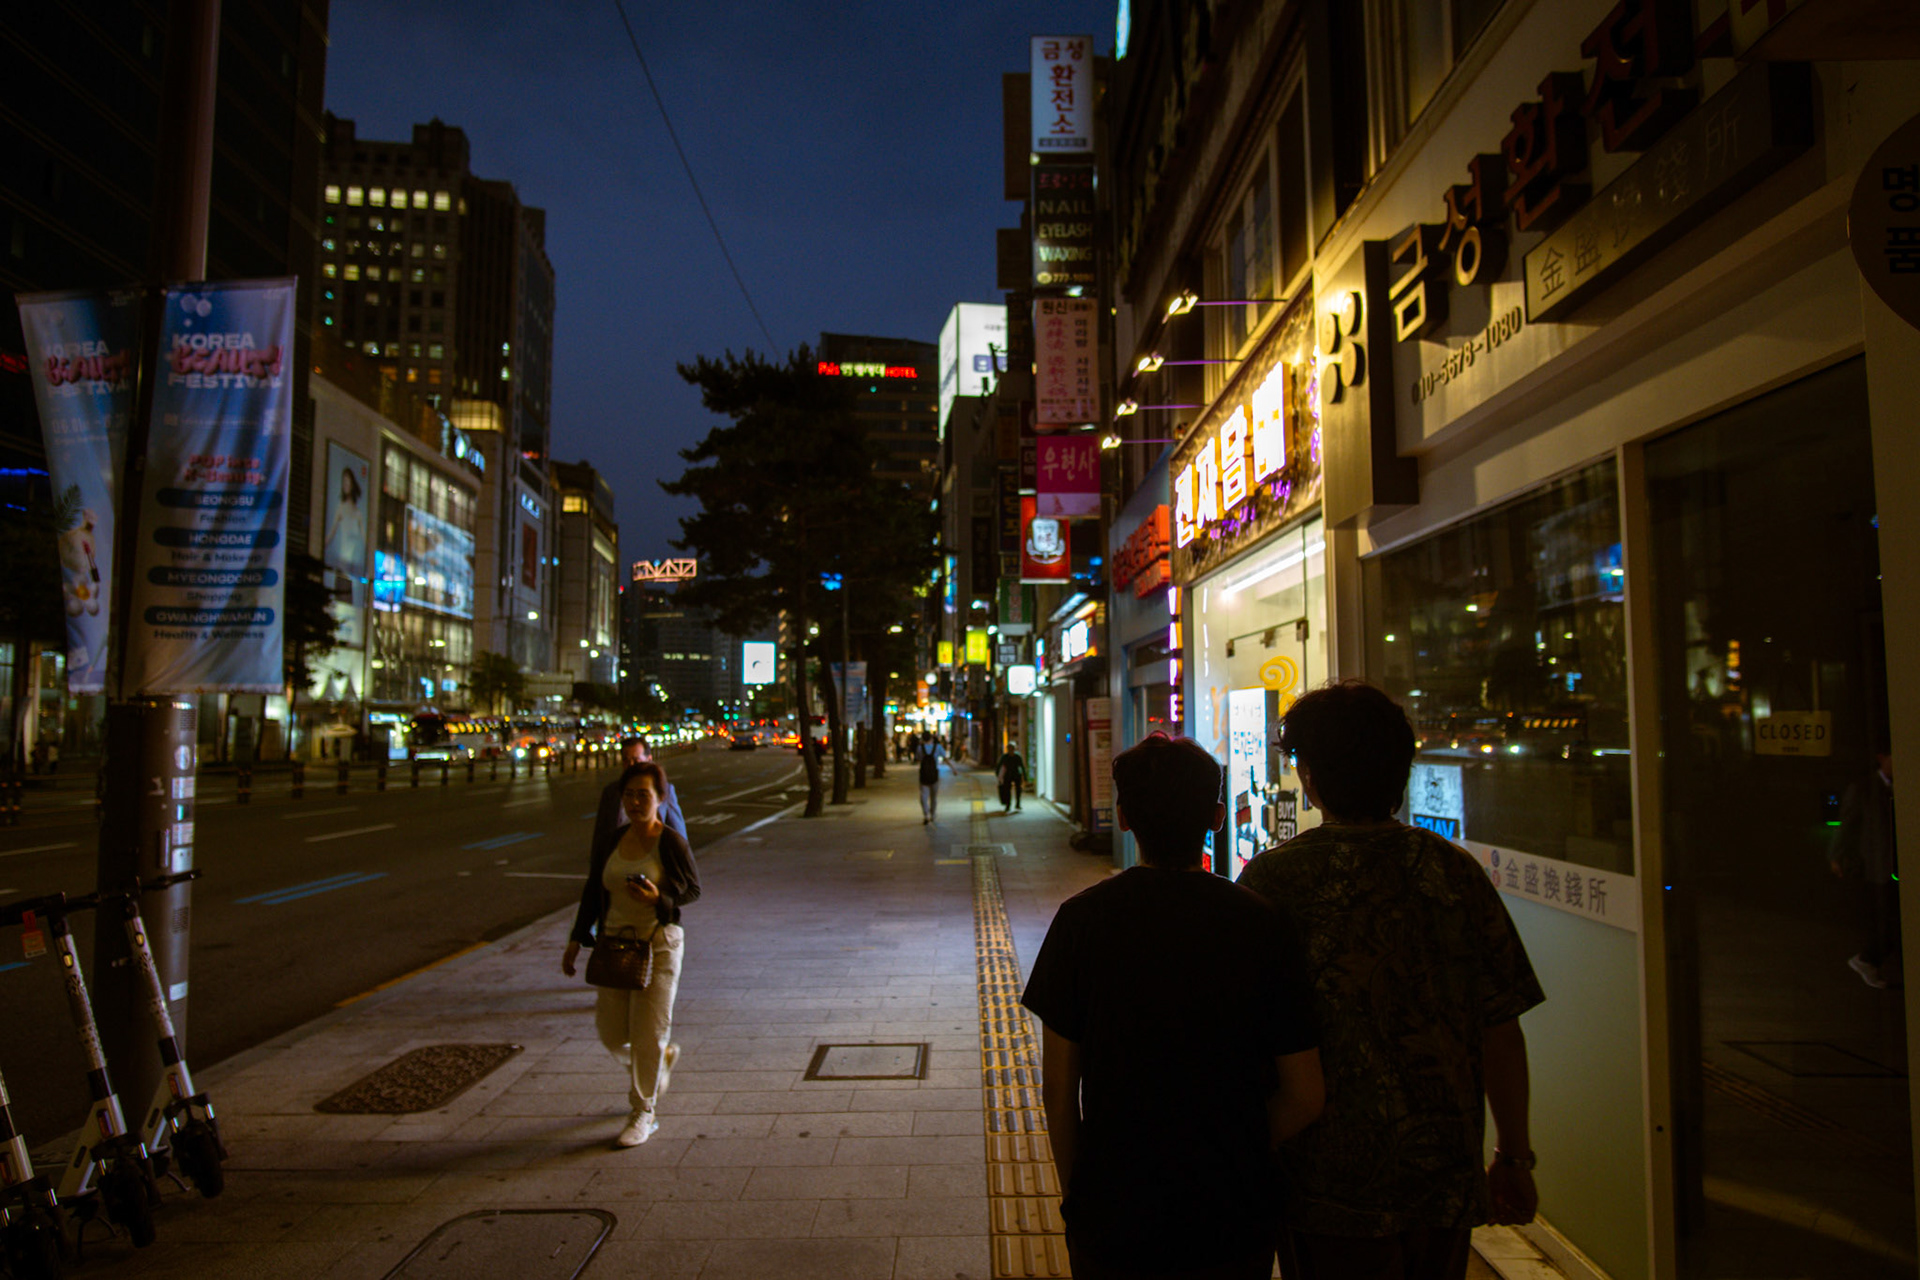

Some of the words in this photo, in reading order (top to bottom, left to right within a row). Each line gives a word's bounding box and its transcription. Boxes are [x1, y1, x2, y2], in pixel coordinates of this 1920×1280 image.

[1042, 41, 1084, 60] 금성
[1050, 64, 1075, 134] 환전소
[1389, 0, 1719, 342] 금성환전
[1039, 200, 1092, 214] NAIL
[1039, 222, 1092, 238] EYELASH
[1039, 246, 1092, 262] WAXING
[171, 332, 256, 350] KOREA
[45, 339, 111, 358] KOREA
[1411, 306, 1522, 405] 010-5678-1080
[886, 366, 918, 379] HOTEL
[167, 373, 284, 390] FESTIVAL
[189, 455, 224, 468] POP
[195, 494, 255, 506] SEONGSU
[200, 513, 247, 524] Fashion
[188, 533, 253, 545] HONGDAE
[171, 551, 199, 561] Hair
[202, 552, 211, 561] &
[167, 572, 264, 584] MYEONGDONG
[186, 591, 243, 602] Shopping
[155, 611, 267, 624] GWANGHWAMUN
[153, 629, 197, 640] Health
[200, 630, 209, 640] &
[211, 630, 265, 640] Wellness
[1758, 724, 1826, 741] CLOSED
